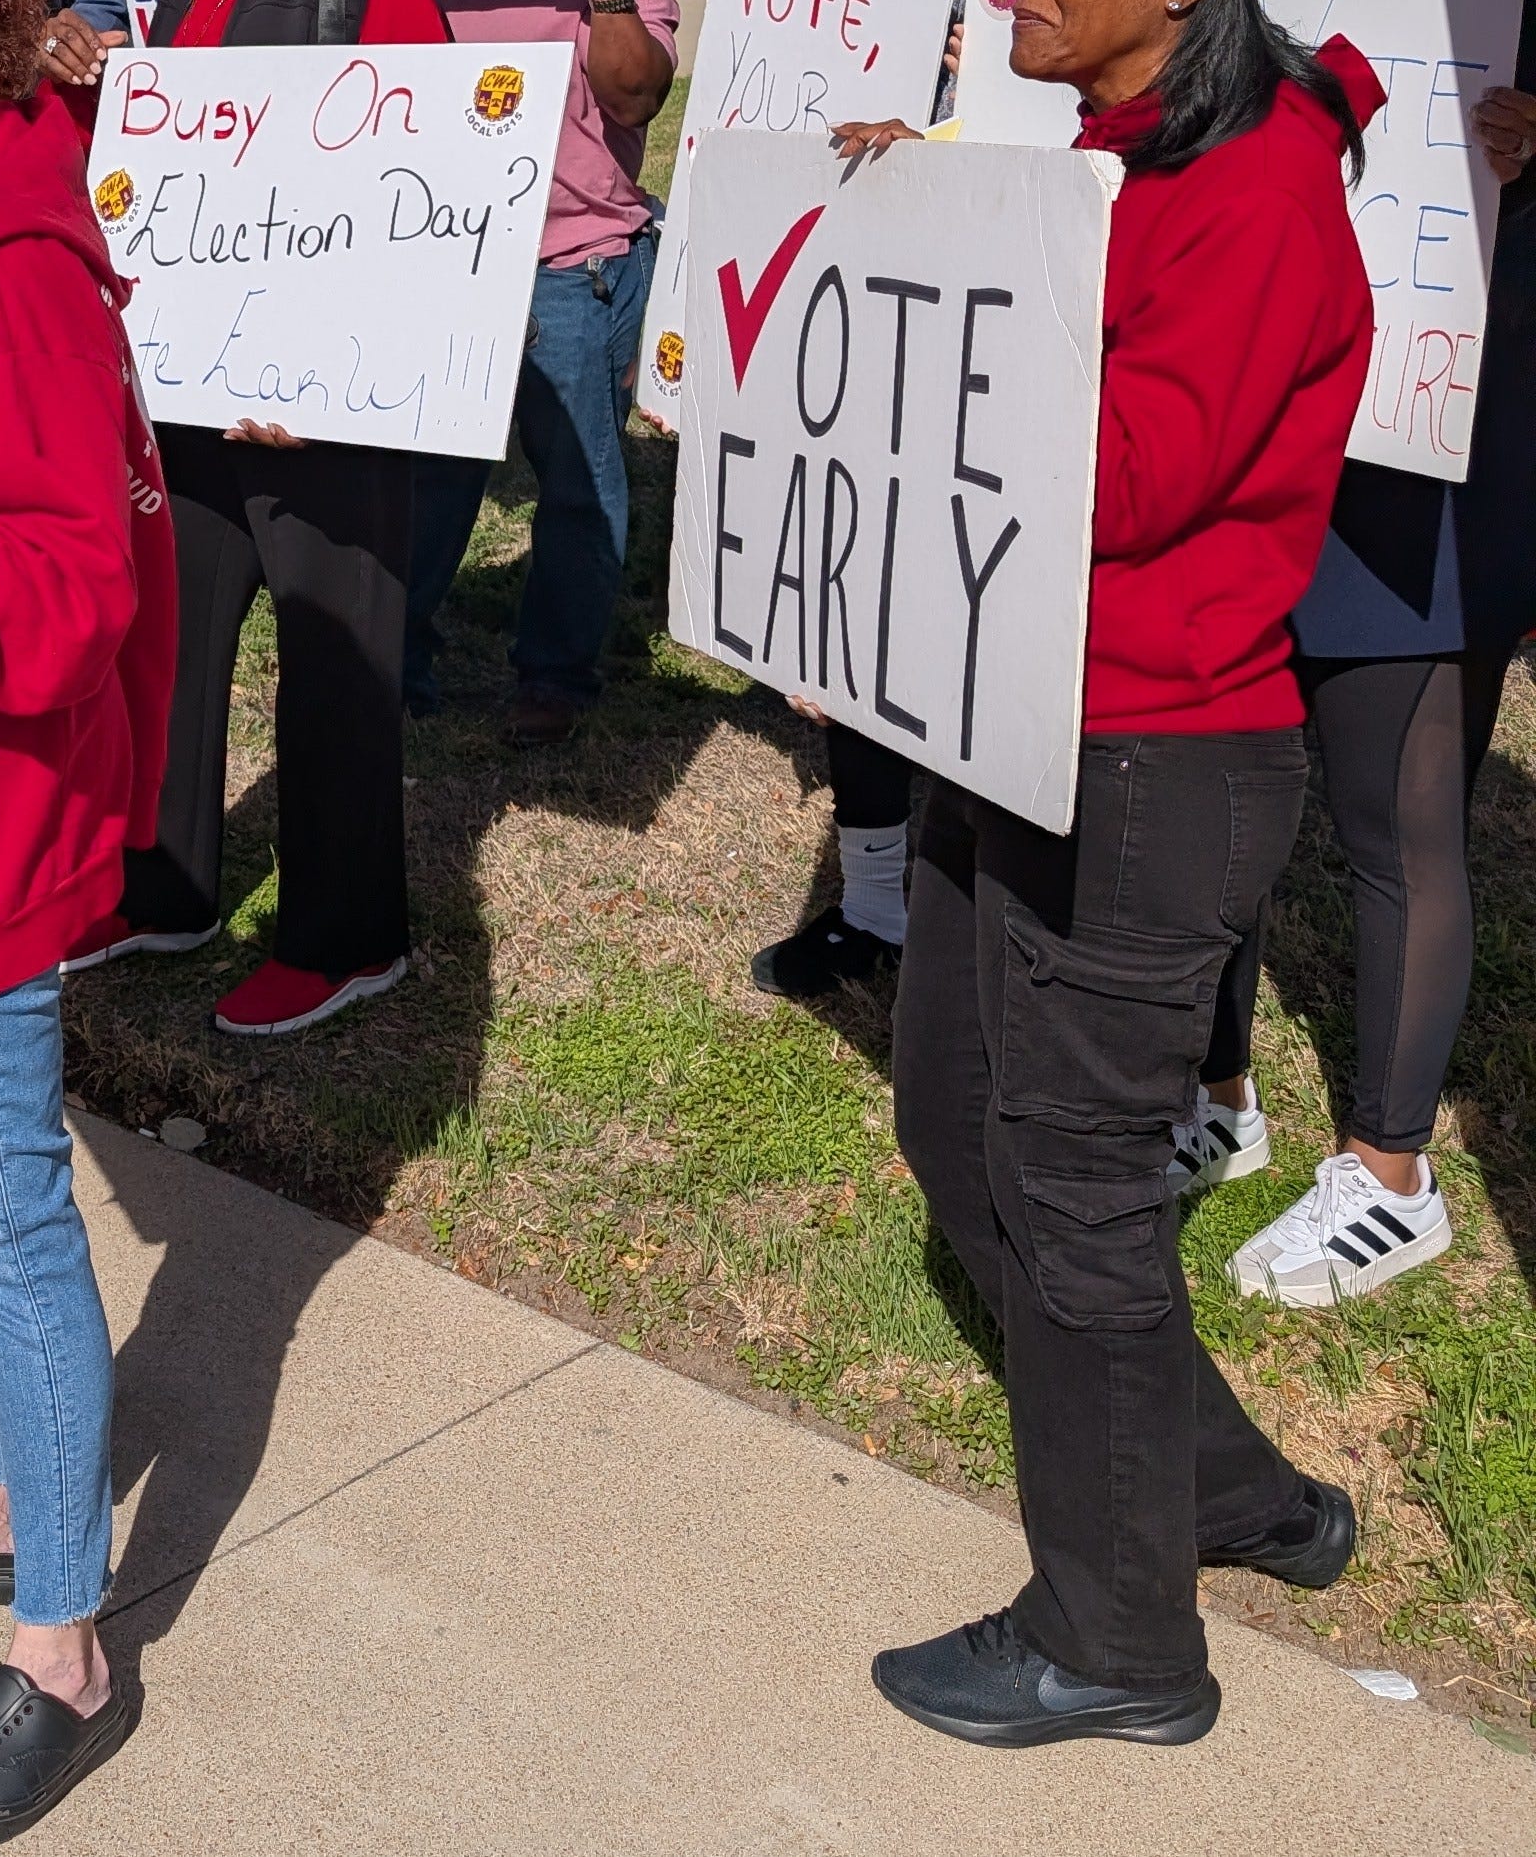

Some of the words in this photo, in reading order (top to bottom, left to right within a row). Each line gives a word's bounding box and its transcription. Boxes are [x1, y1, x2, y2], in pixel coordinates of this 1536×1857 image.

[484, 73, 519, 90] CWA
[465, 108, 492, 137] LOCAL
[99, 173, 124, 201] CWA
[125, 172, 354, 267] Election
[380, 156, 539, 275] Day?
[714, 432, 1021, 761] EARLY
